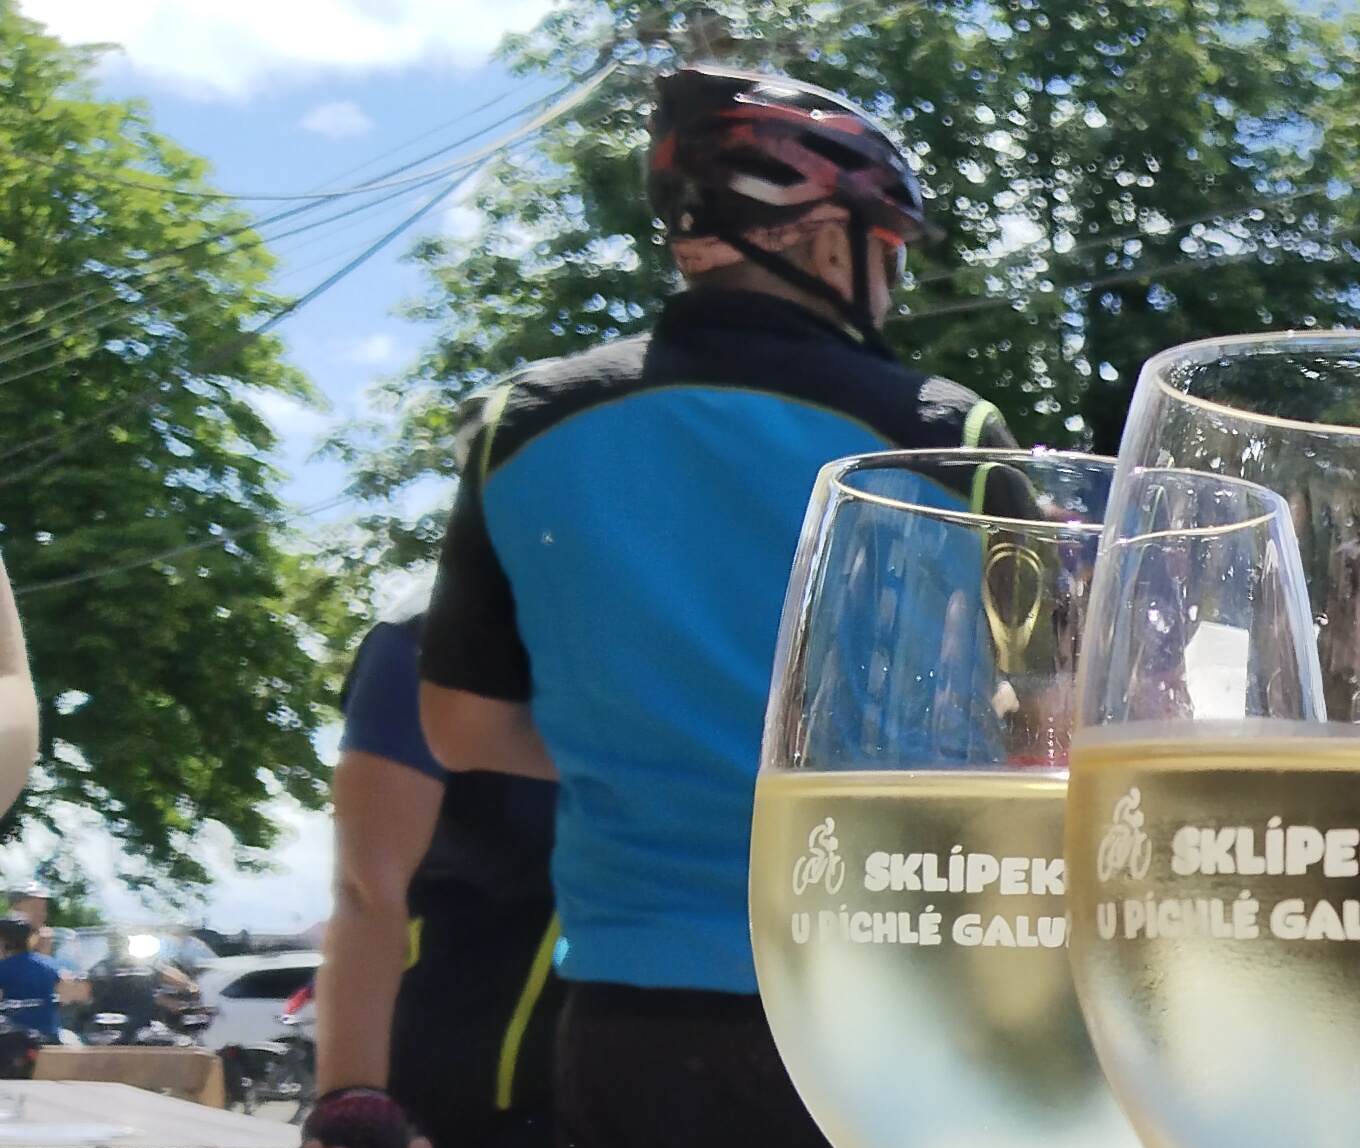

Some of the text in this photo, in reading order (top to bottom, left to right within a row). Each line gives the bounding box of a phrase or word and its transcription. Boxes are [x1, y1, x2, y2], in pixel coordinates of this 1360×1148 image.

[864, 844, 1067, 896] SKLÍPEK
[791, 904, 1071, 949] U PÍCHLÉ GALU
[1096, 902, 1118, 941] U
[1123, 888, 1261, 941] PÍCHLÉ
